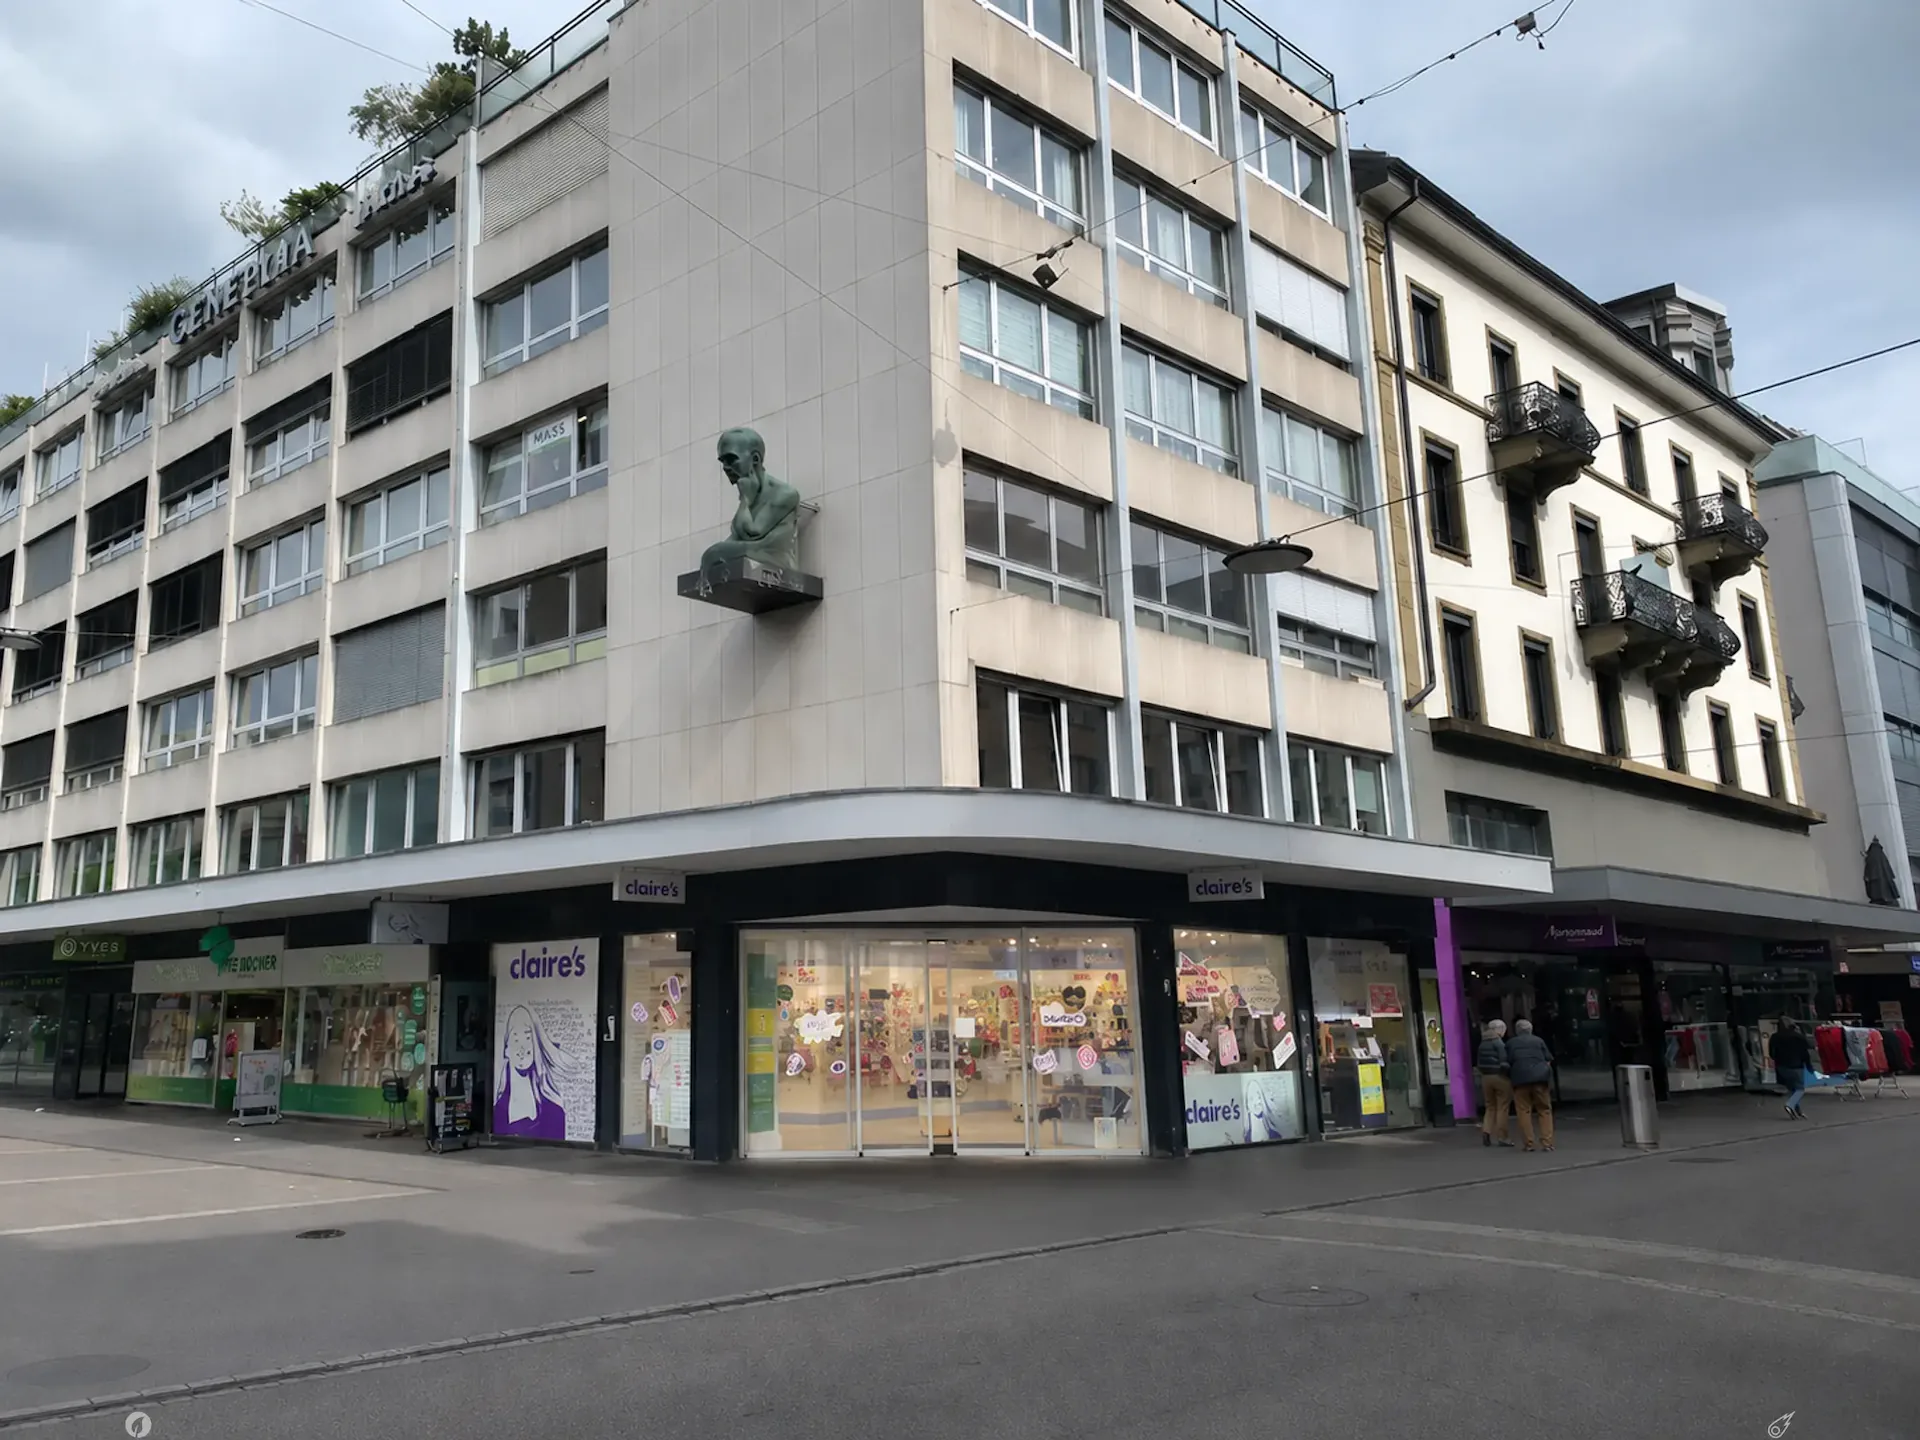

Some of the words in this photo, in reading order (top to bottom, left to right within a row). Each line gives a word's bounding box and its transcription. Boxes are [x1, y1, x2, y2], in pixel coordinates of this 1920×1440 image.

[533, 422, 565, 444] MASS
[625, 879, 679, 897] claire's
[1195, 877, 1253, 896] claire's
[81, 941, 119, 953] YVES
[510, 945, 586, 979] claire's
[1185, 1098, 1241, 1124] claire's
